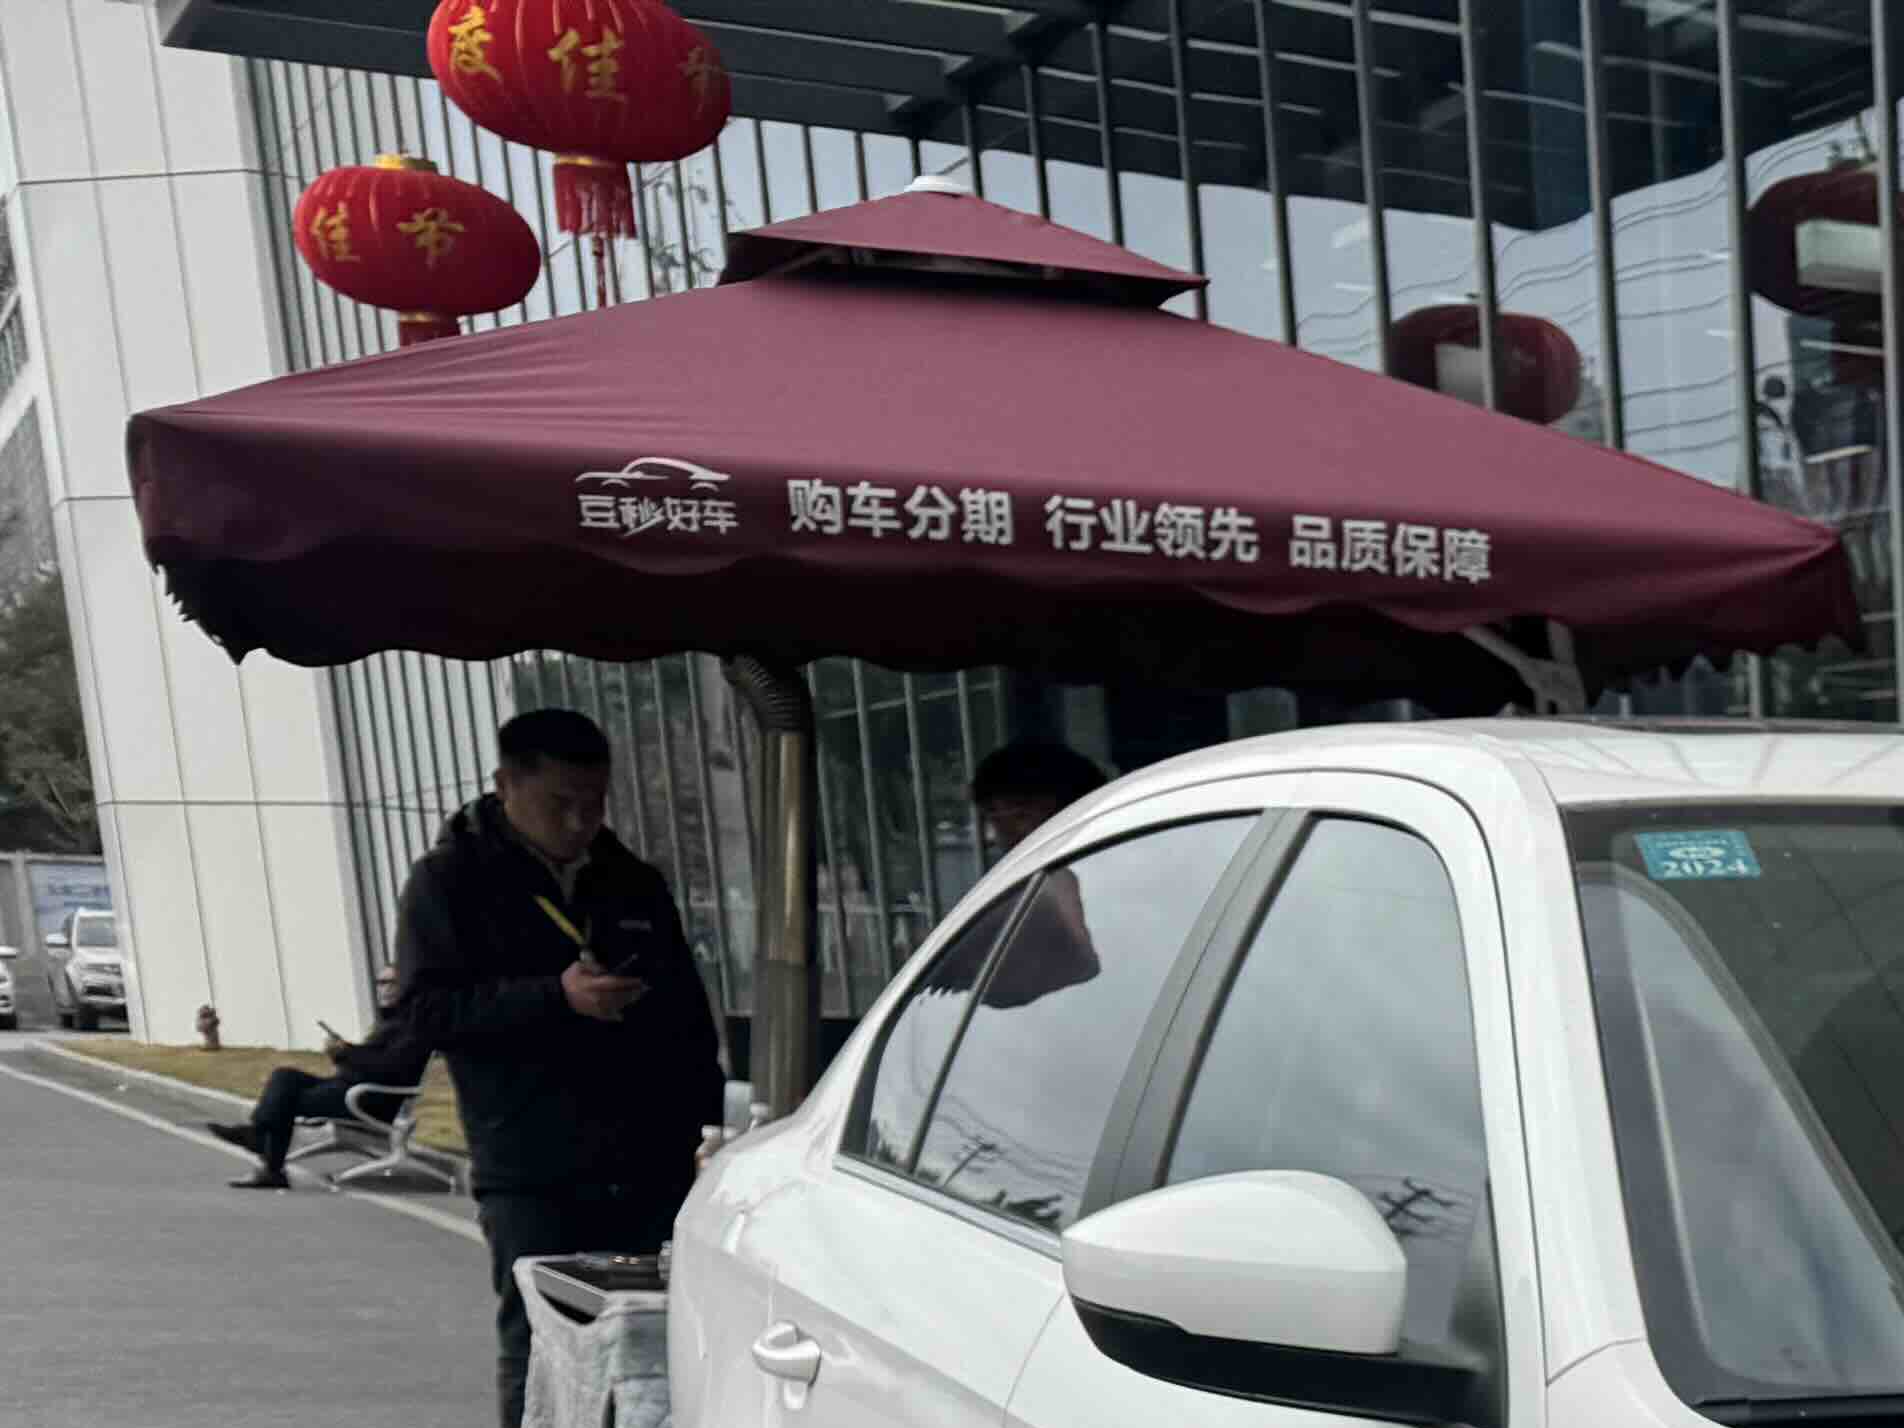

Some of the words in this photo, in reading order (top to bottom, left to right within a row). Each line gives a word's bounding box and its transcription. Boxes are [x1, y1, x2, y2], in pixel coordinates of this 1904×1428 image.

[787, 478, 1015, 546] 购车分期
[1044, 494, 1261, 563] 行业领先
[1288, 513, 1494, 585] 品质保障
